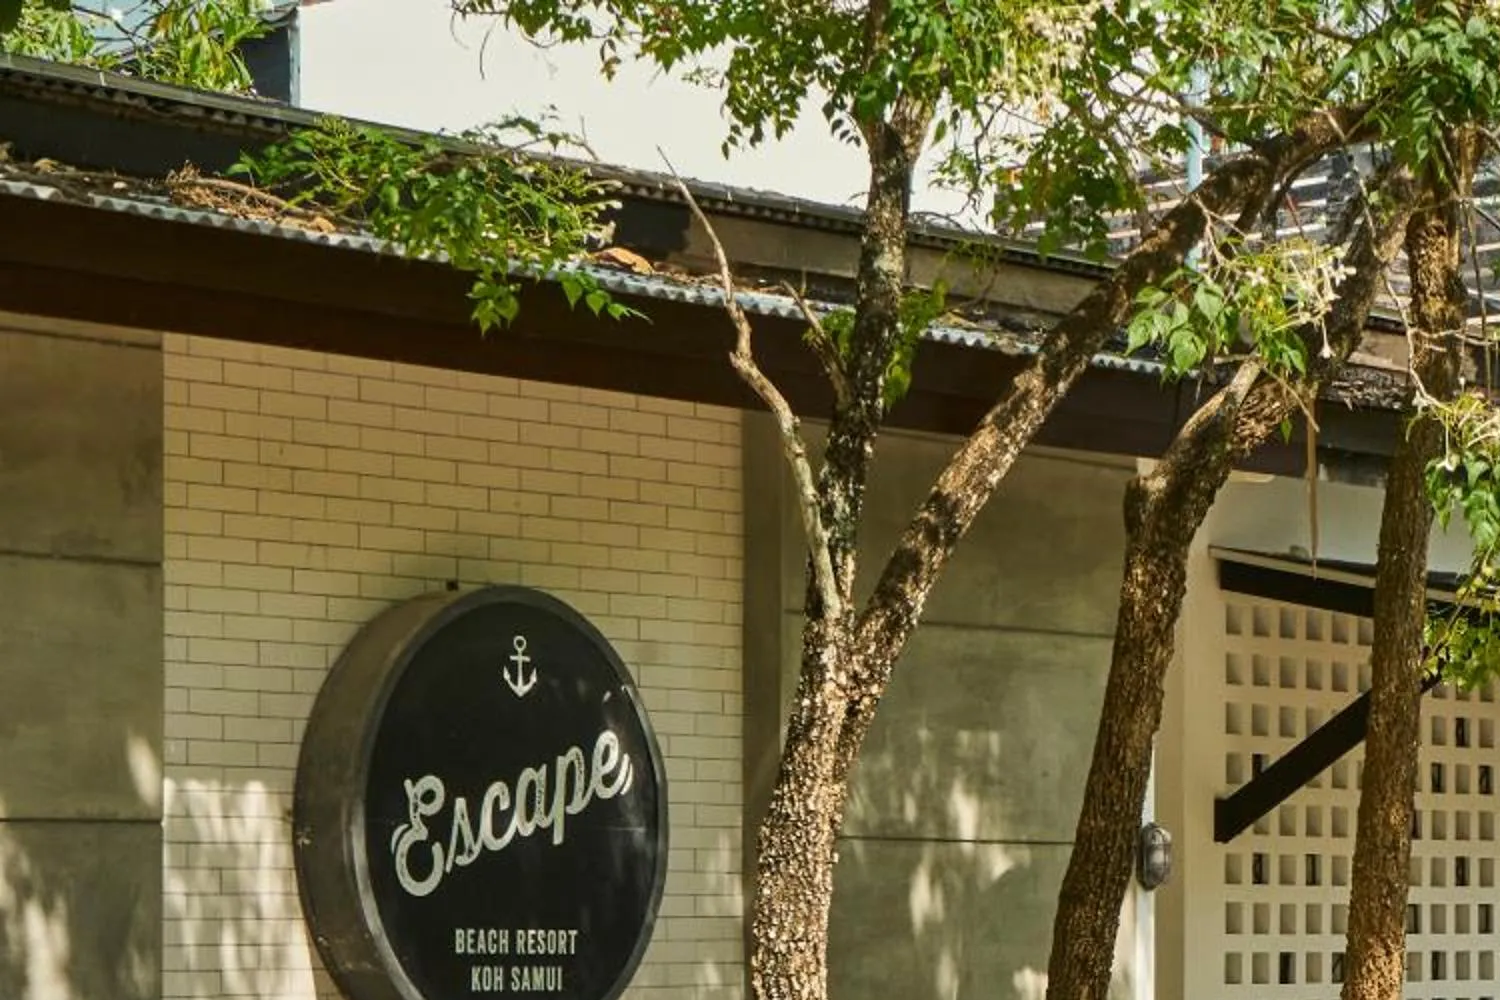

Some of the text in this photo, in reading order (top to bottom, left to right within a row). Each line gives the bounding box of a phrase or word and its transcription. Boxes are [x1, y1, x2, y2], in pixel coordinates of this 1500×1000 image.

[391, 730, 633, 896] Escape
[455, 928, 578, 955] BEACH RESORT
[471, 966, 562, 992] KOH SAMUI
